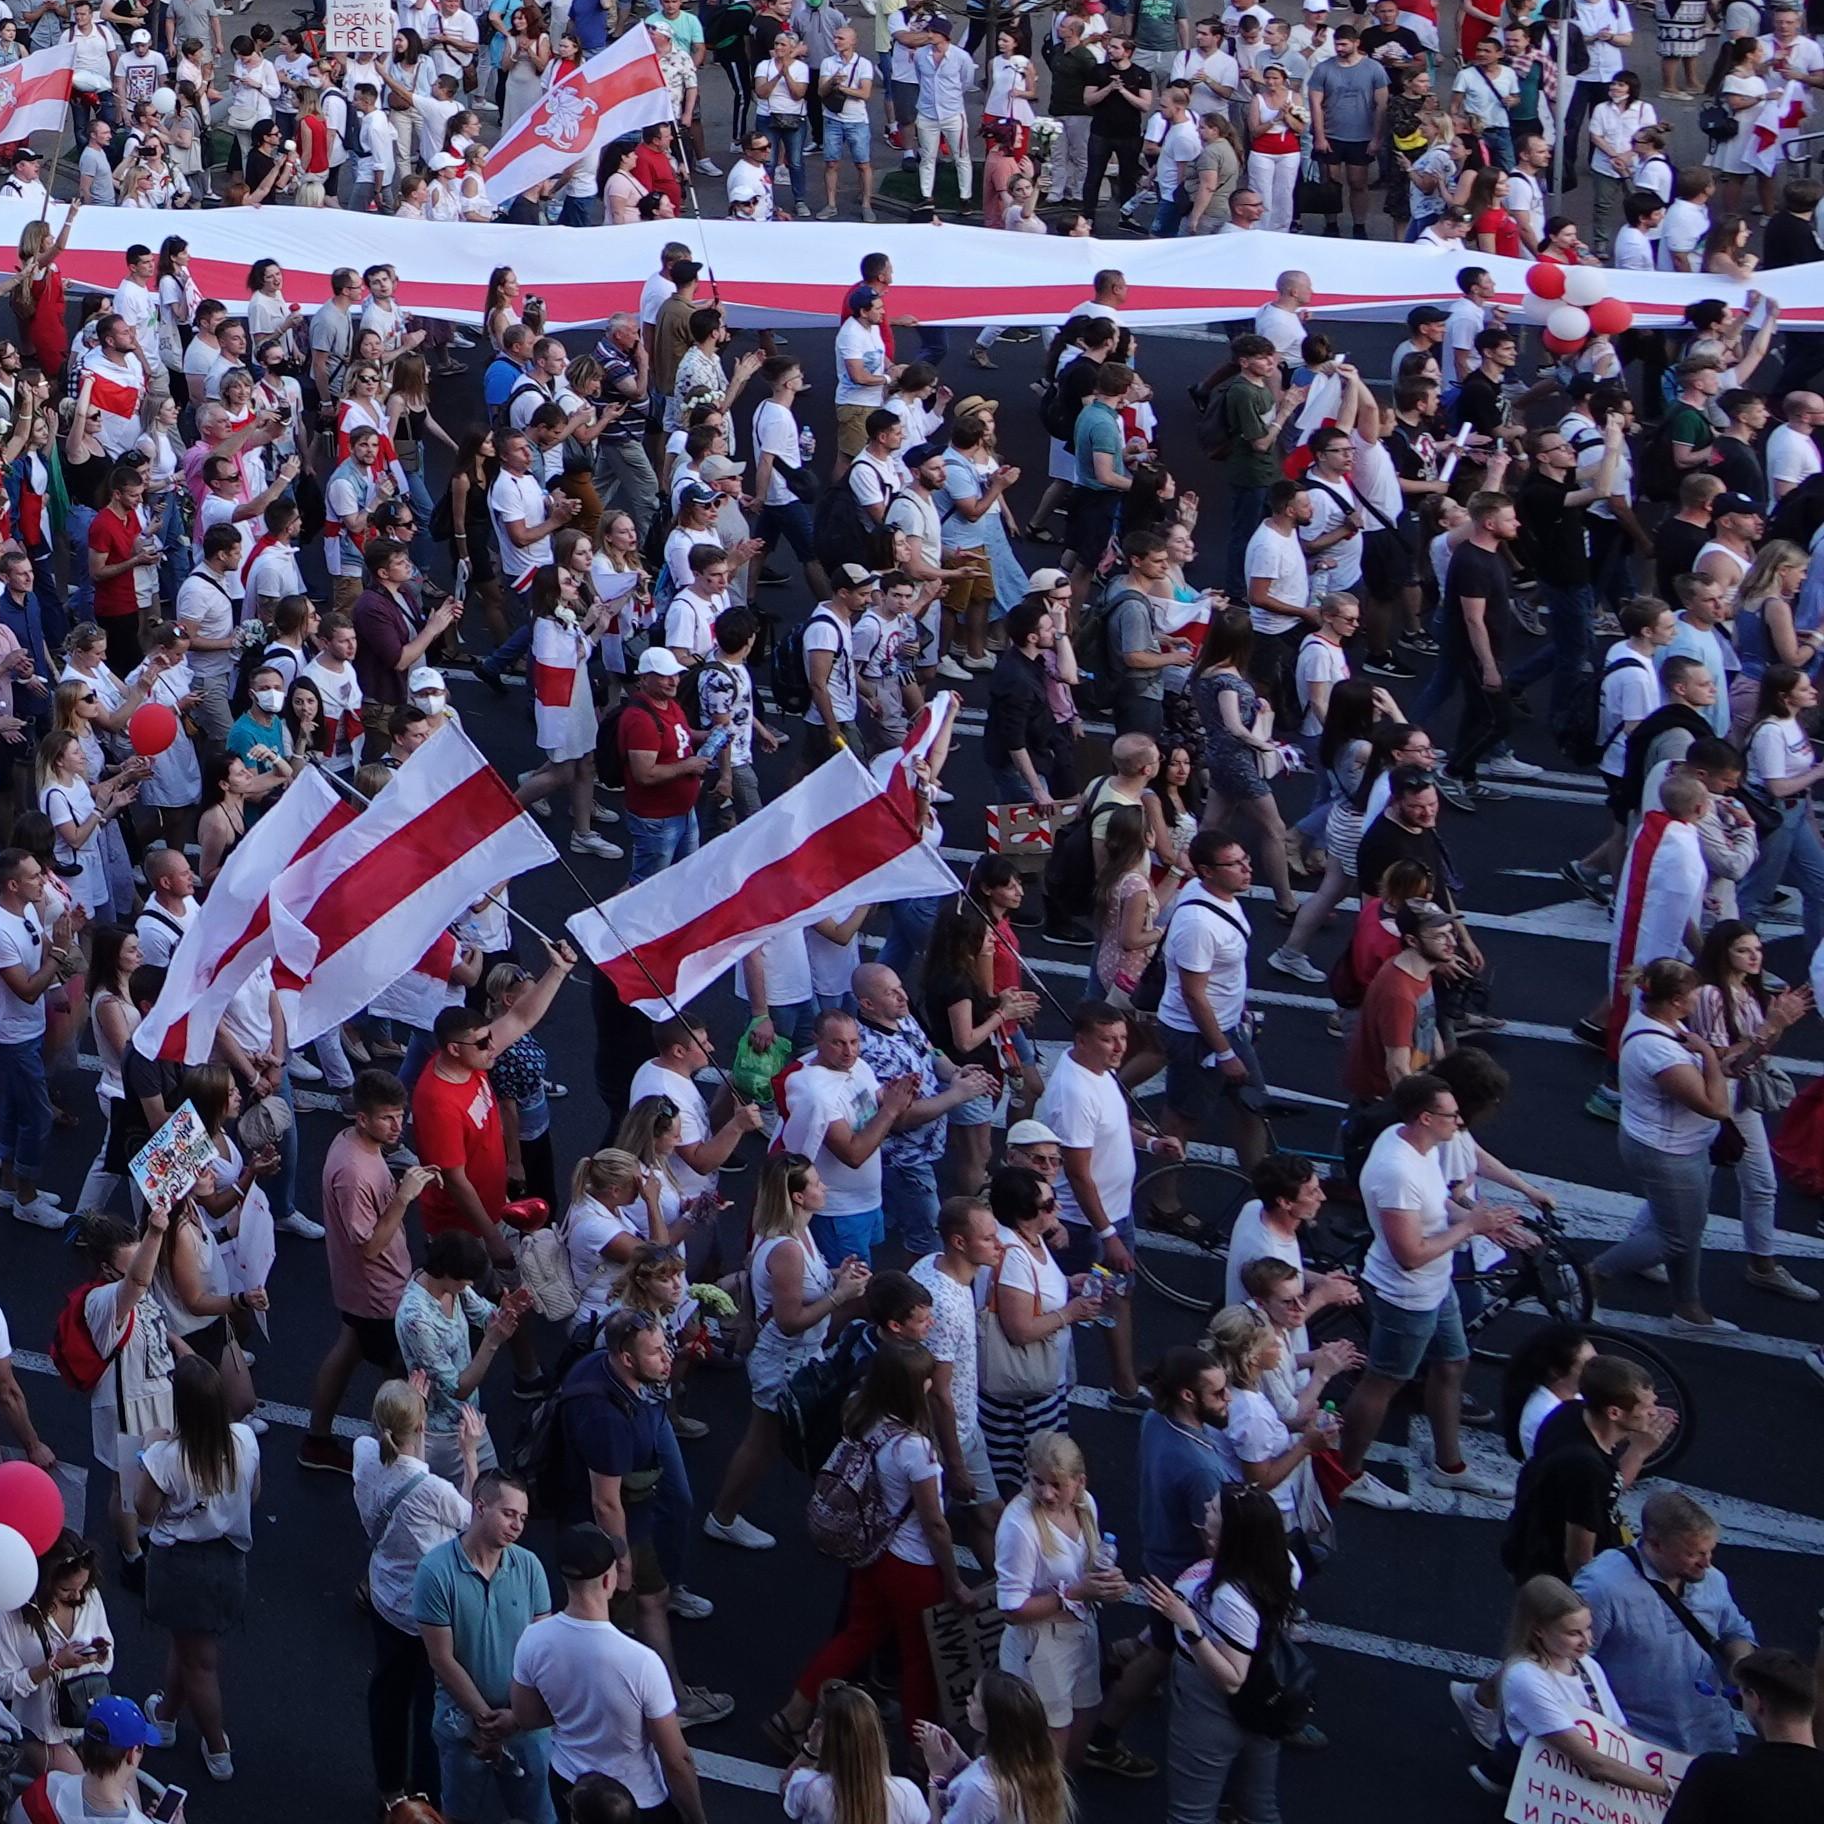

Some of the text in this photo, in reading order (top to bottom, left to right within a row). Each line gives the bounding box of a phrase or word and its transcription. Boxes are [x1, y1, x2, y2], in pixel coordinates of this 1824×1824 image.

[333, 12, 386, 27] BREAK
[334, 31, 384, 48] FREE
[131, 1127, 170, 1173] BELARUS
[932, 1607, 972, 1680] WANT
[1645, 1751, 1663, 1778] Я
[1524, 1802, 1539, 1822] И
